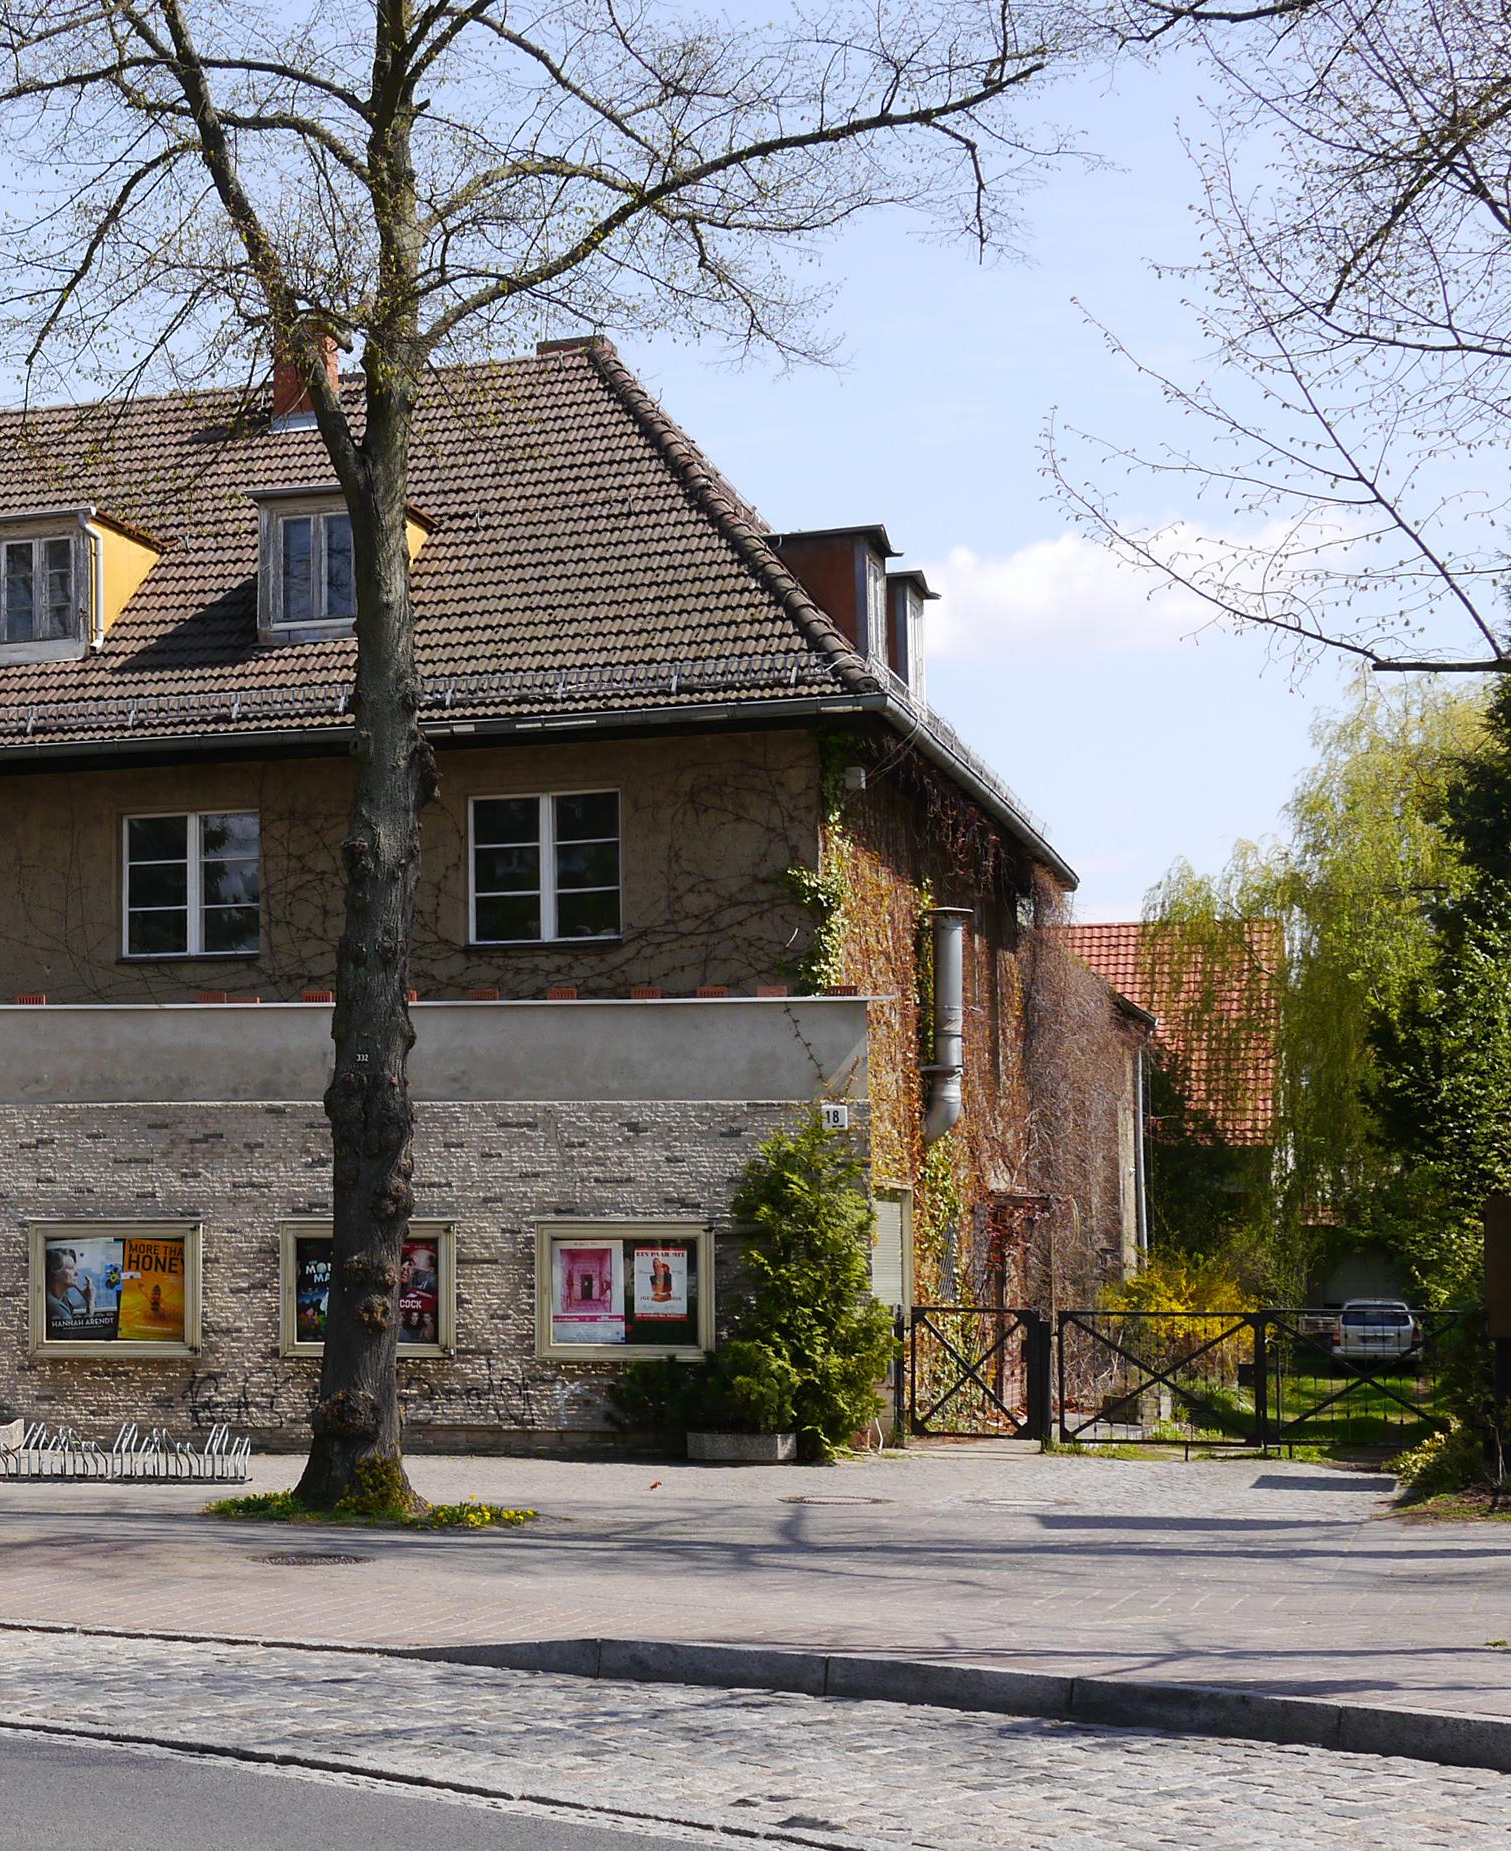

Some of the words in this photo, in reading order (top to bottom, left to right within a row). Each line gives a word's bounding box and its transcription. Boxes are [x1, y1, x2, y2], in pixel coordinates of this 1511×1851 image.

[356, 1054, 368, 1062] 332
[826, 1110, 840, 1123] 18
[129, 1243, 159, 1255] MORE
[51, 1319, 84, 1328] HANNAH
[85, 1317, 114, 1325] ARENDT
